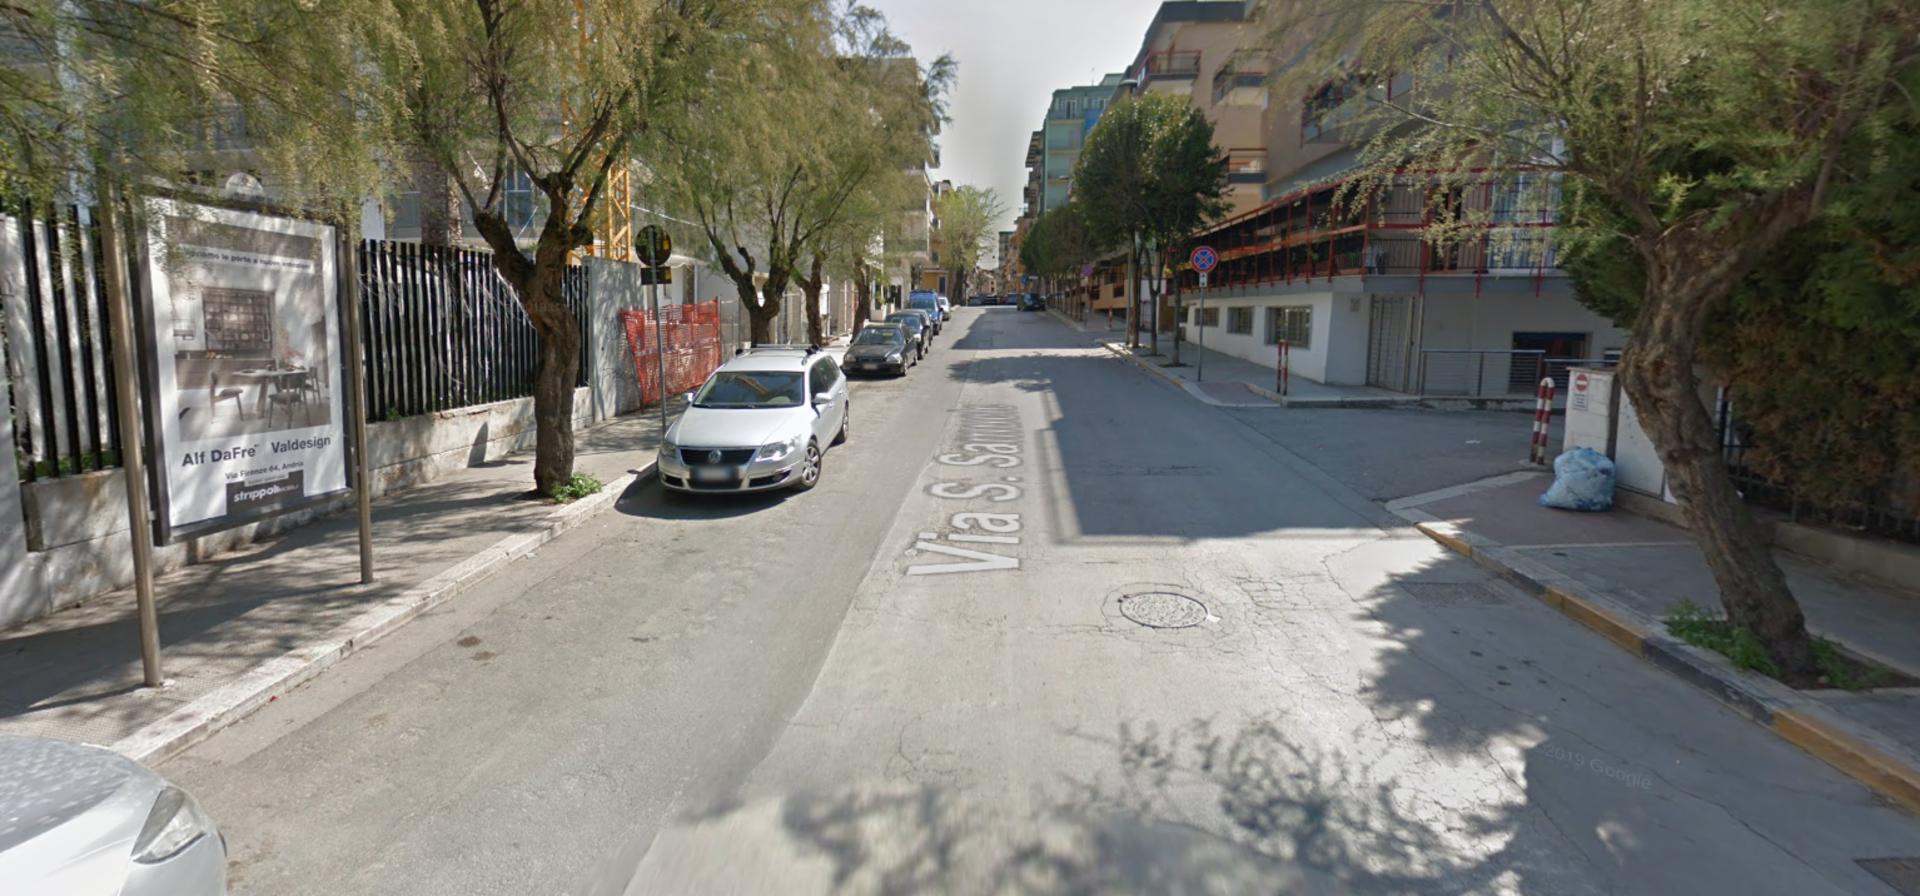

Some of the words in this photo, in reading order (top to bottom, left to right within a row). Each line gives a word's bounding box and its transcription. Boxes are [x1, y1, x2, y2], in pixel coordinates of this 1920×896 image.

[182, 451, 205, 467] Alf
[271, 436, 331, 453] Valdesign
[225, 471, 238, 479] Via
[240, 467, 267, 477] Firenze
